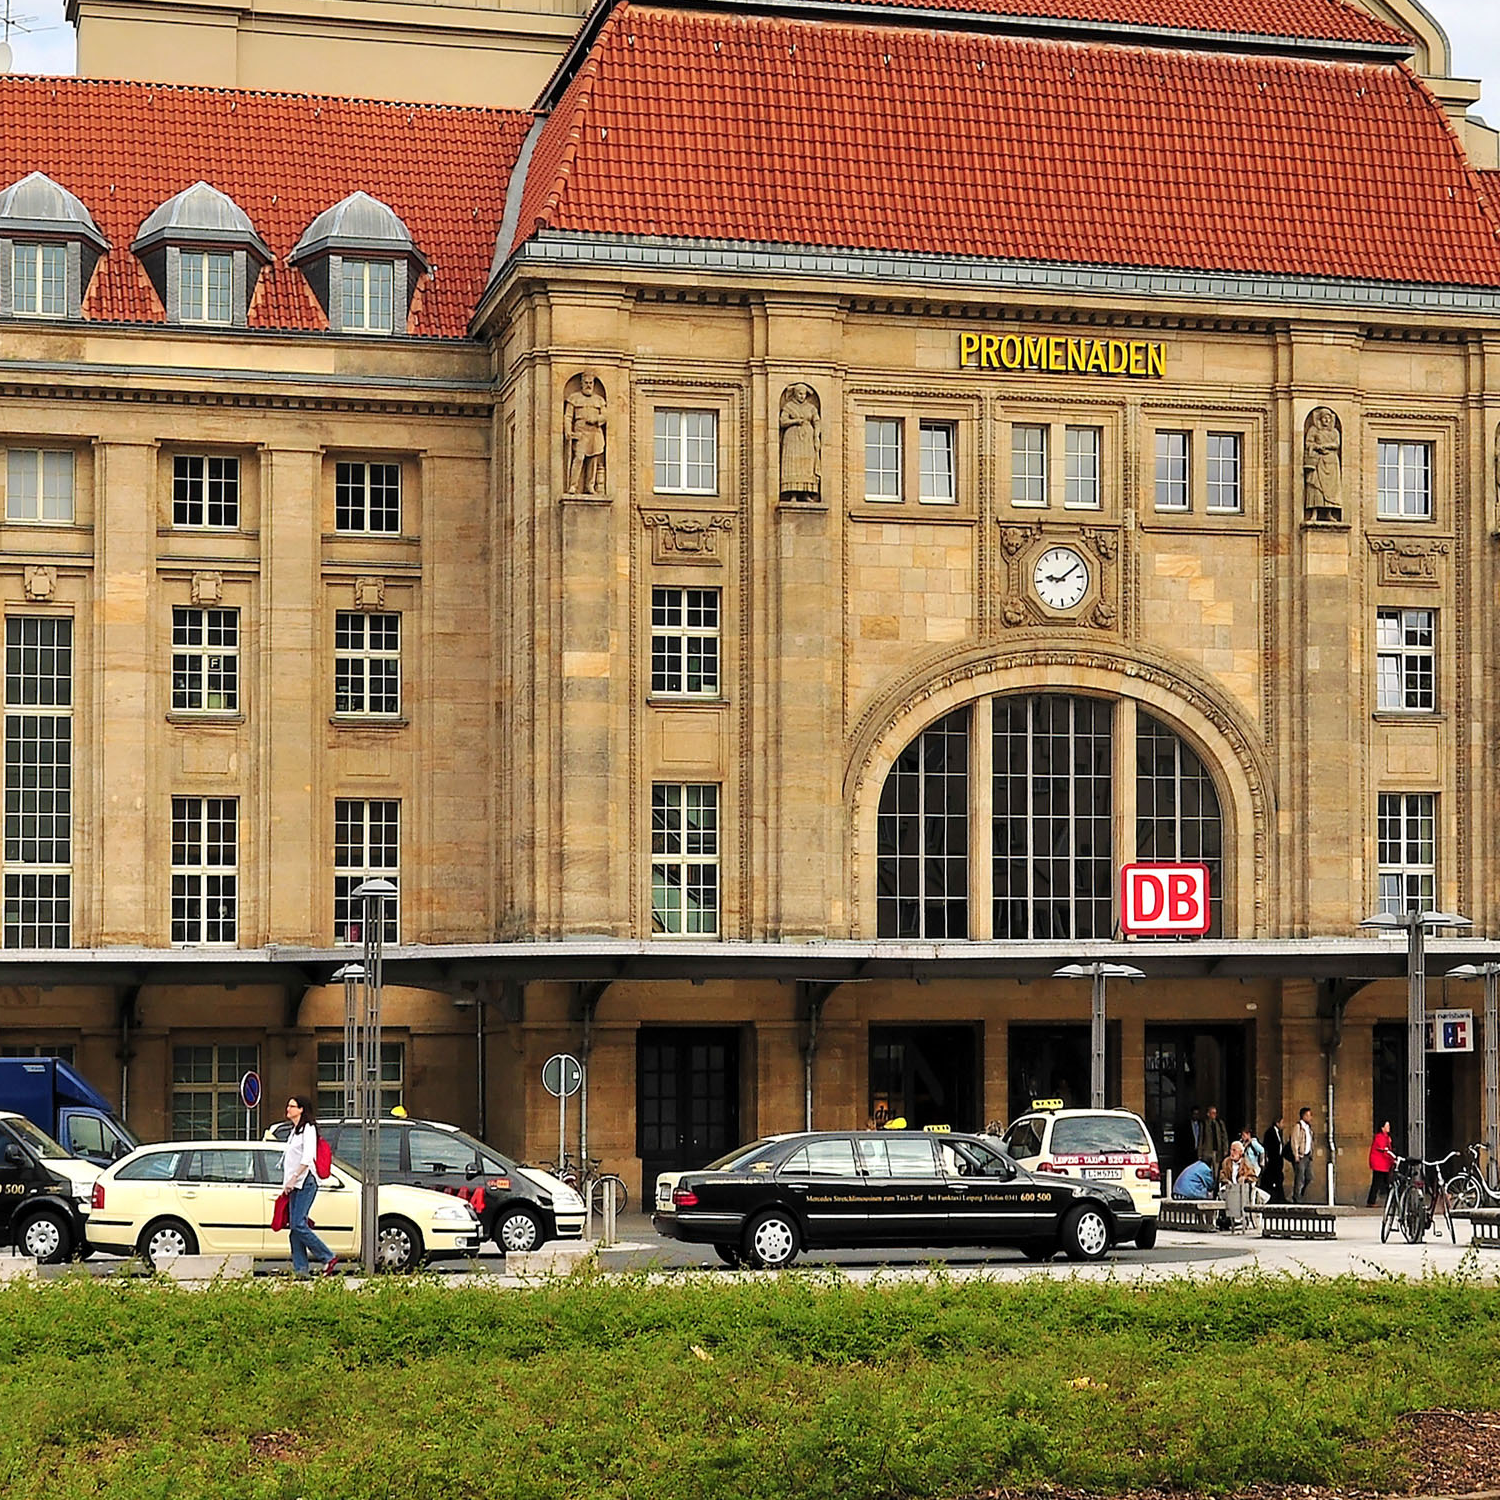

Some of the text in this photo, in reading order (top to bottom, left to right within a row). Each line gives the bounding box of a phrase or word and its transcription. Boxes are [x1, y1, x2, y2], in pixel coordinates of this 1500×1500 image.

[960, 333, 1167, 376] PROMENADEN
[1133, 874, 1199, 921] DB
[5, 1184, 25, 1194] 500
[1021, 1192, 1035, 1202] 600
[1037, 1193, 1052, 1202] 500
